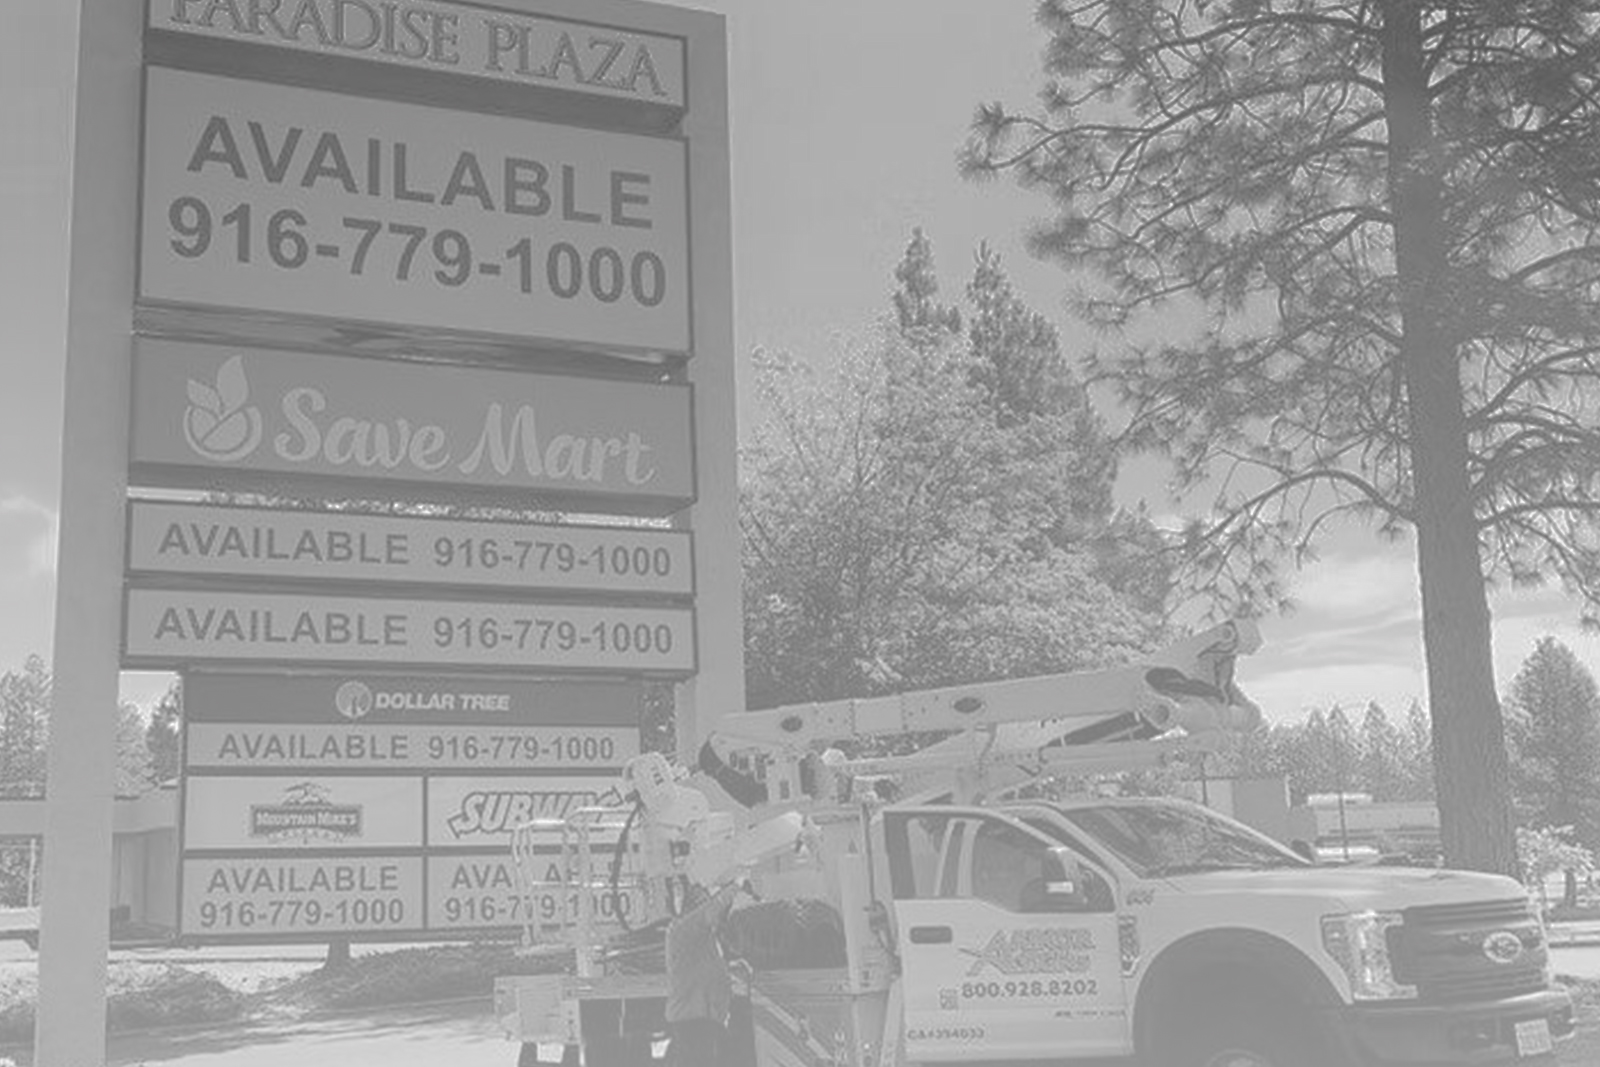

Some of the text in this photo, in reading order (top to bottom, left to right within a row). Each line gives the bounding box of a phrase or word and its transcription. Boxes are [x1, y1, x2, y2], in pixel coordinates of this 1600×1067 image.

[483, 19, 669, 98] PLAZA
[186, 115, 653, 230] AVAILABLE
[167, 195, 667, 307] 916-779-1000
[273, 386, 657, 485] Save Mart
[158, 522, 672, 578] AVAILABLE 916-779-1000
[153, 606, 673, 655] AVAILABLE 916-779-1000
[375, 691, 511, 712] DOLLAR TREE
[217, 733, 615, 761] AVAILABLE 916-779-1000
[207, 865, 399, 894] AVAILABLE
[200, 898, 404, 928] 916-779-1000
[961, 978, 1099, 999] 800.928.8202
